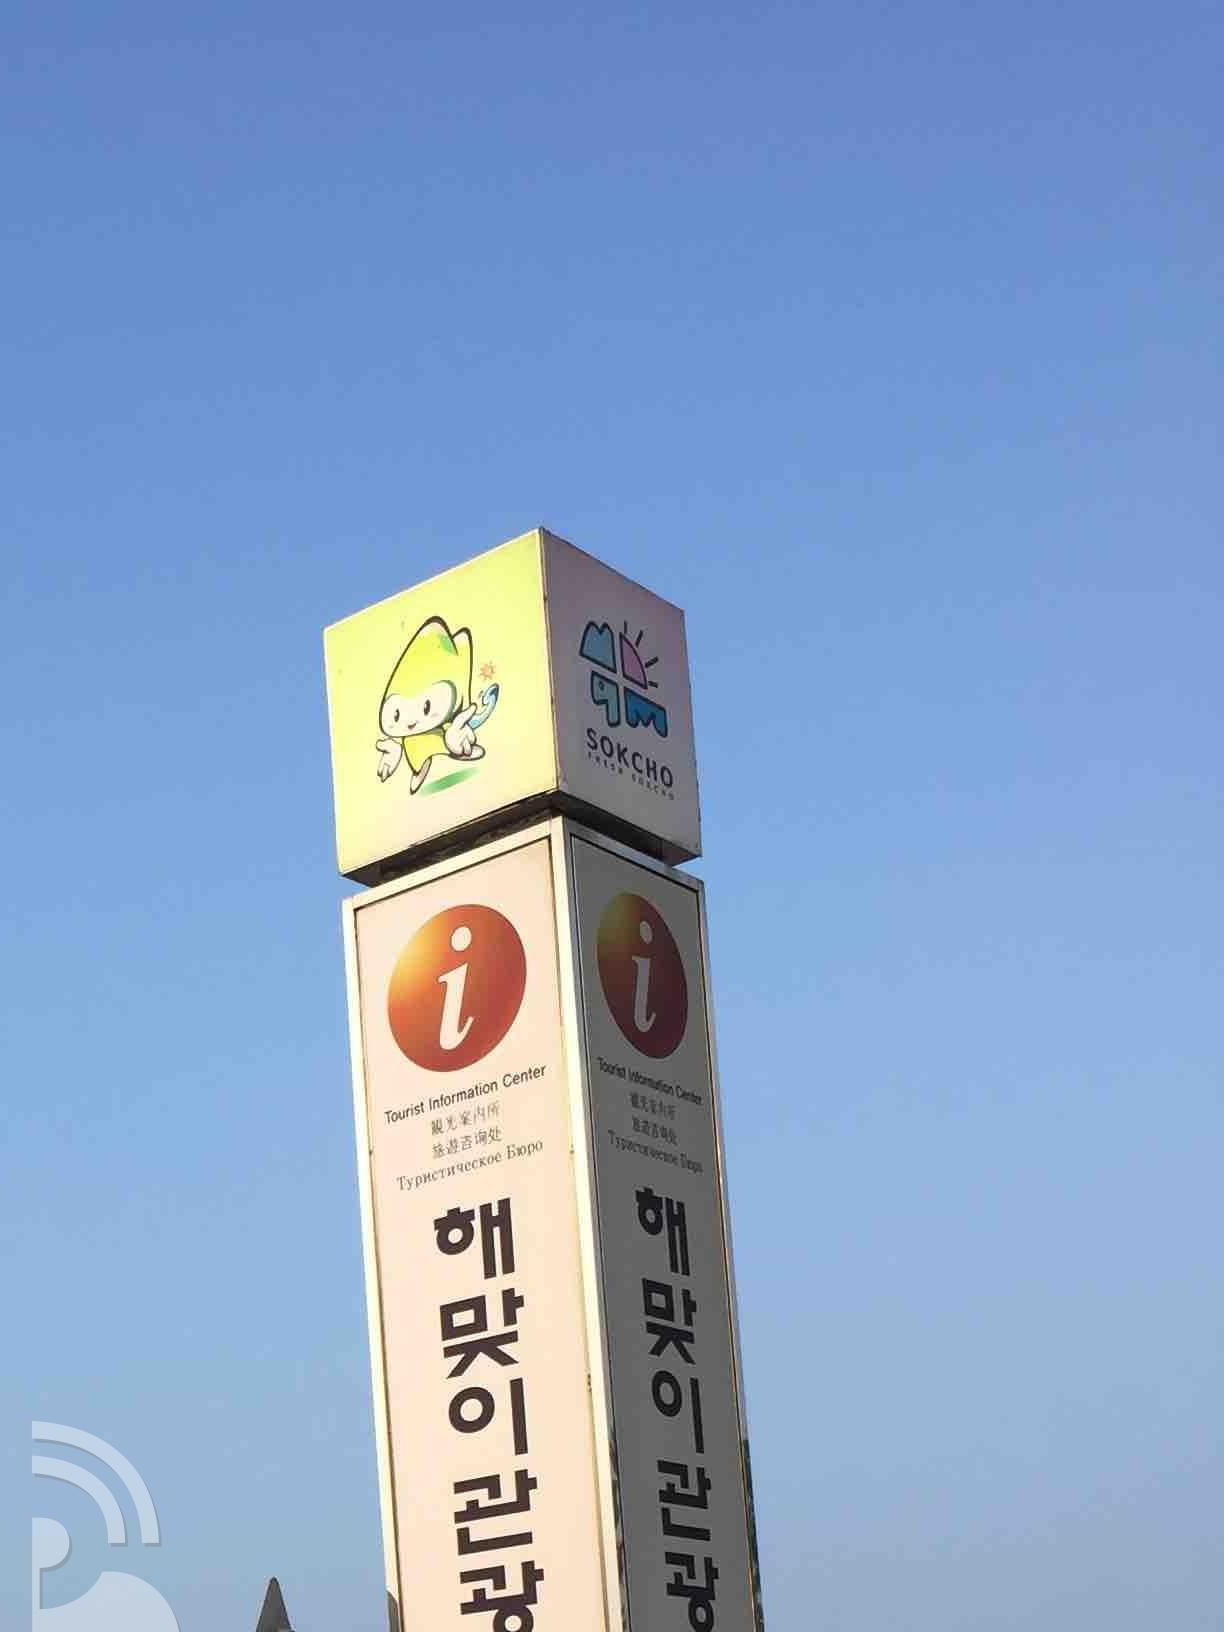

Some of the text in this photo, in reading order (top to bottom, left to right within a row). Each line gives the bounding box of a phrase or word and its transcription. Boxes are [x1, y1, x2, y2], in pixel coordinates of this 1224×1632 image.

[586, 727, 674, 788] SOKCHO
[383, 1064, 547, 1125] Tourist Information Center
[396, 1139, 544, 1191] Туристическое Бюро
